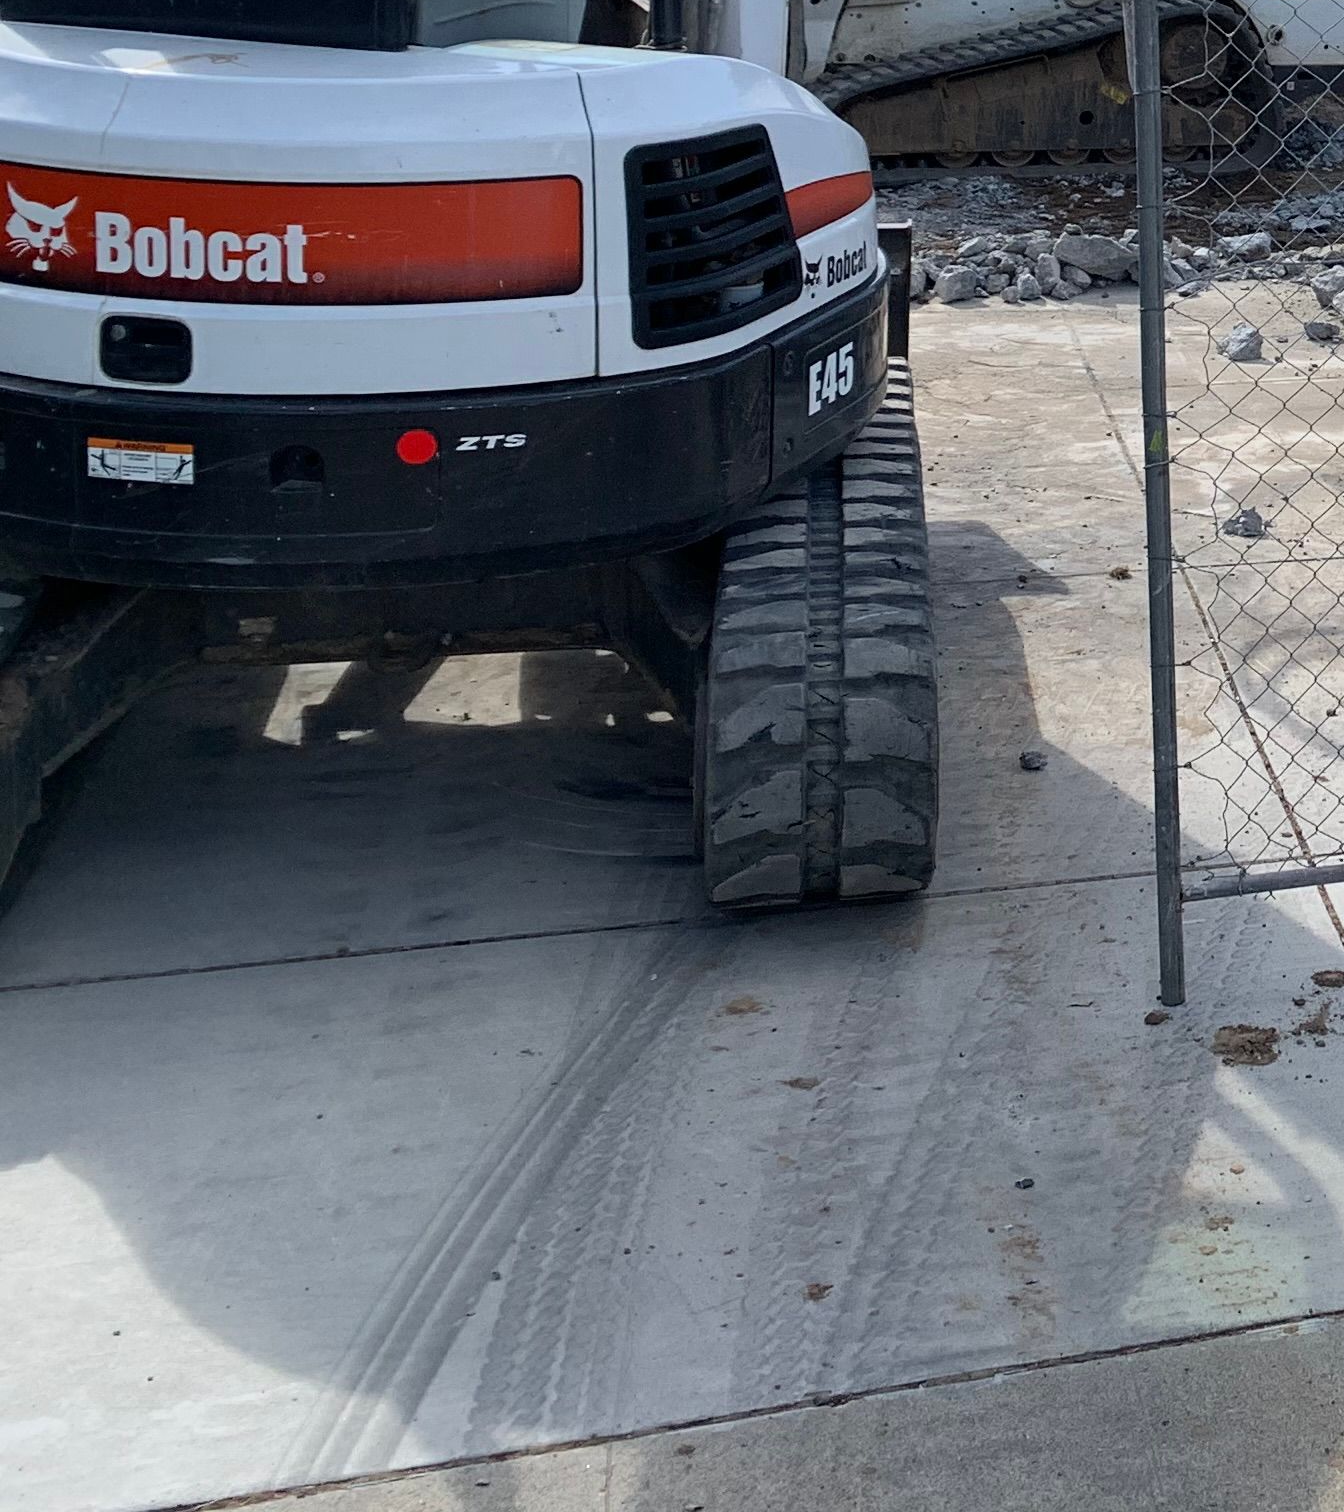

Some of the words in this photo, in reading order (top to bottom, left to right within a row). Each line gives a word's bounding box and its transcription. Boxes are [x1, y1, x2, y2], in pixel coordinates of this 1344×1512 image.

[95, 210, 308, 284] Bobcat
[826, 240, 868, 288] Bobcat
[808, 341, 855, 417] E45
[455, 433, 528, 451] ZTS
